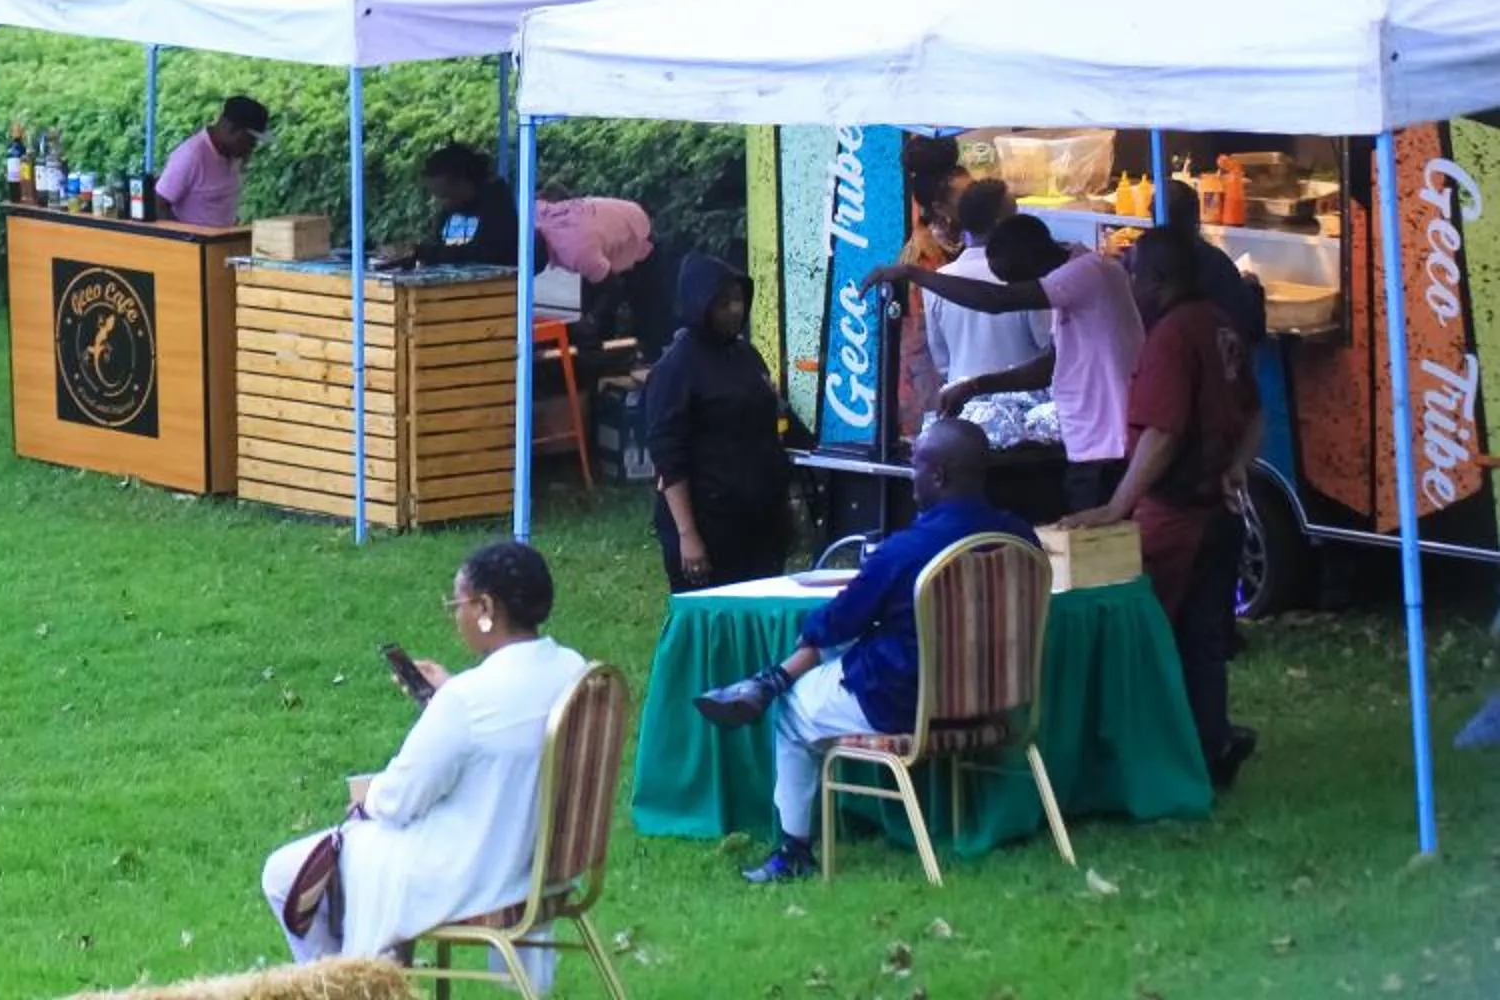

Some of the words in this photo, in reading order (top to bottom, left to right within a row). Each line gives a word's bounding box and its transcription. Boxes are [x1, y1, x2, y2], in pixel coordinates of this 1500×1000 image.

[823, 124, 869, 256] Tribe
[1420, 157, 1482, 327] Geco
[825, 280, 876, 427] Geco
[1421, 353, 1476, 509] Tribe
